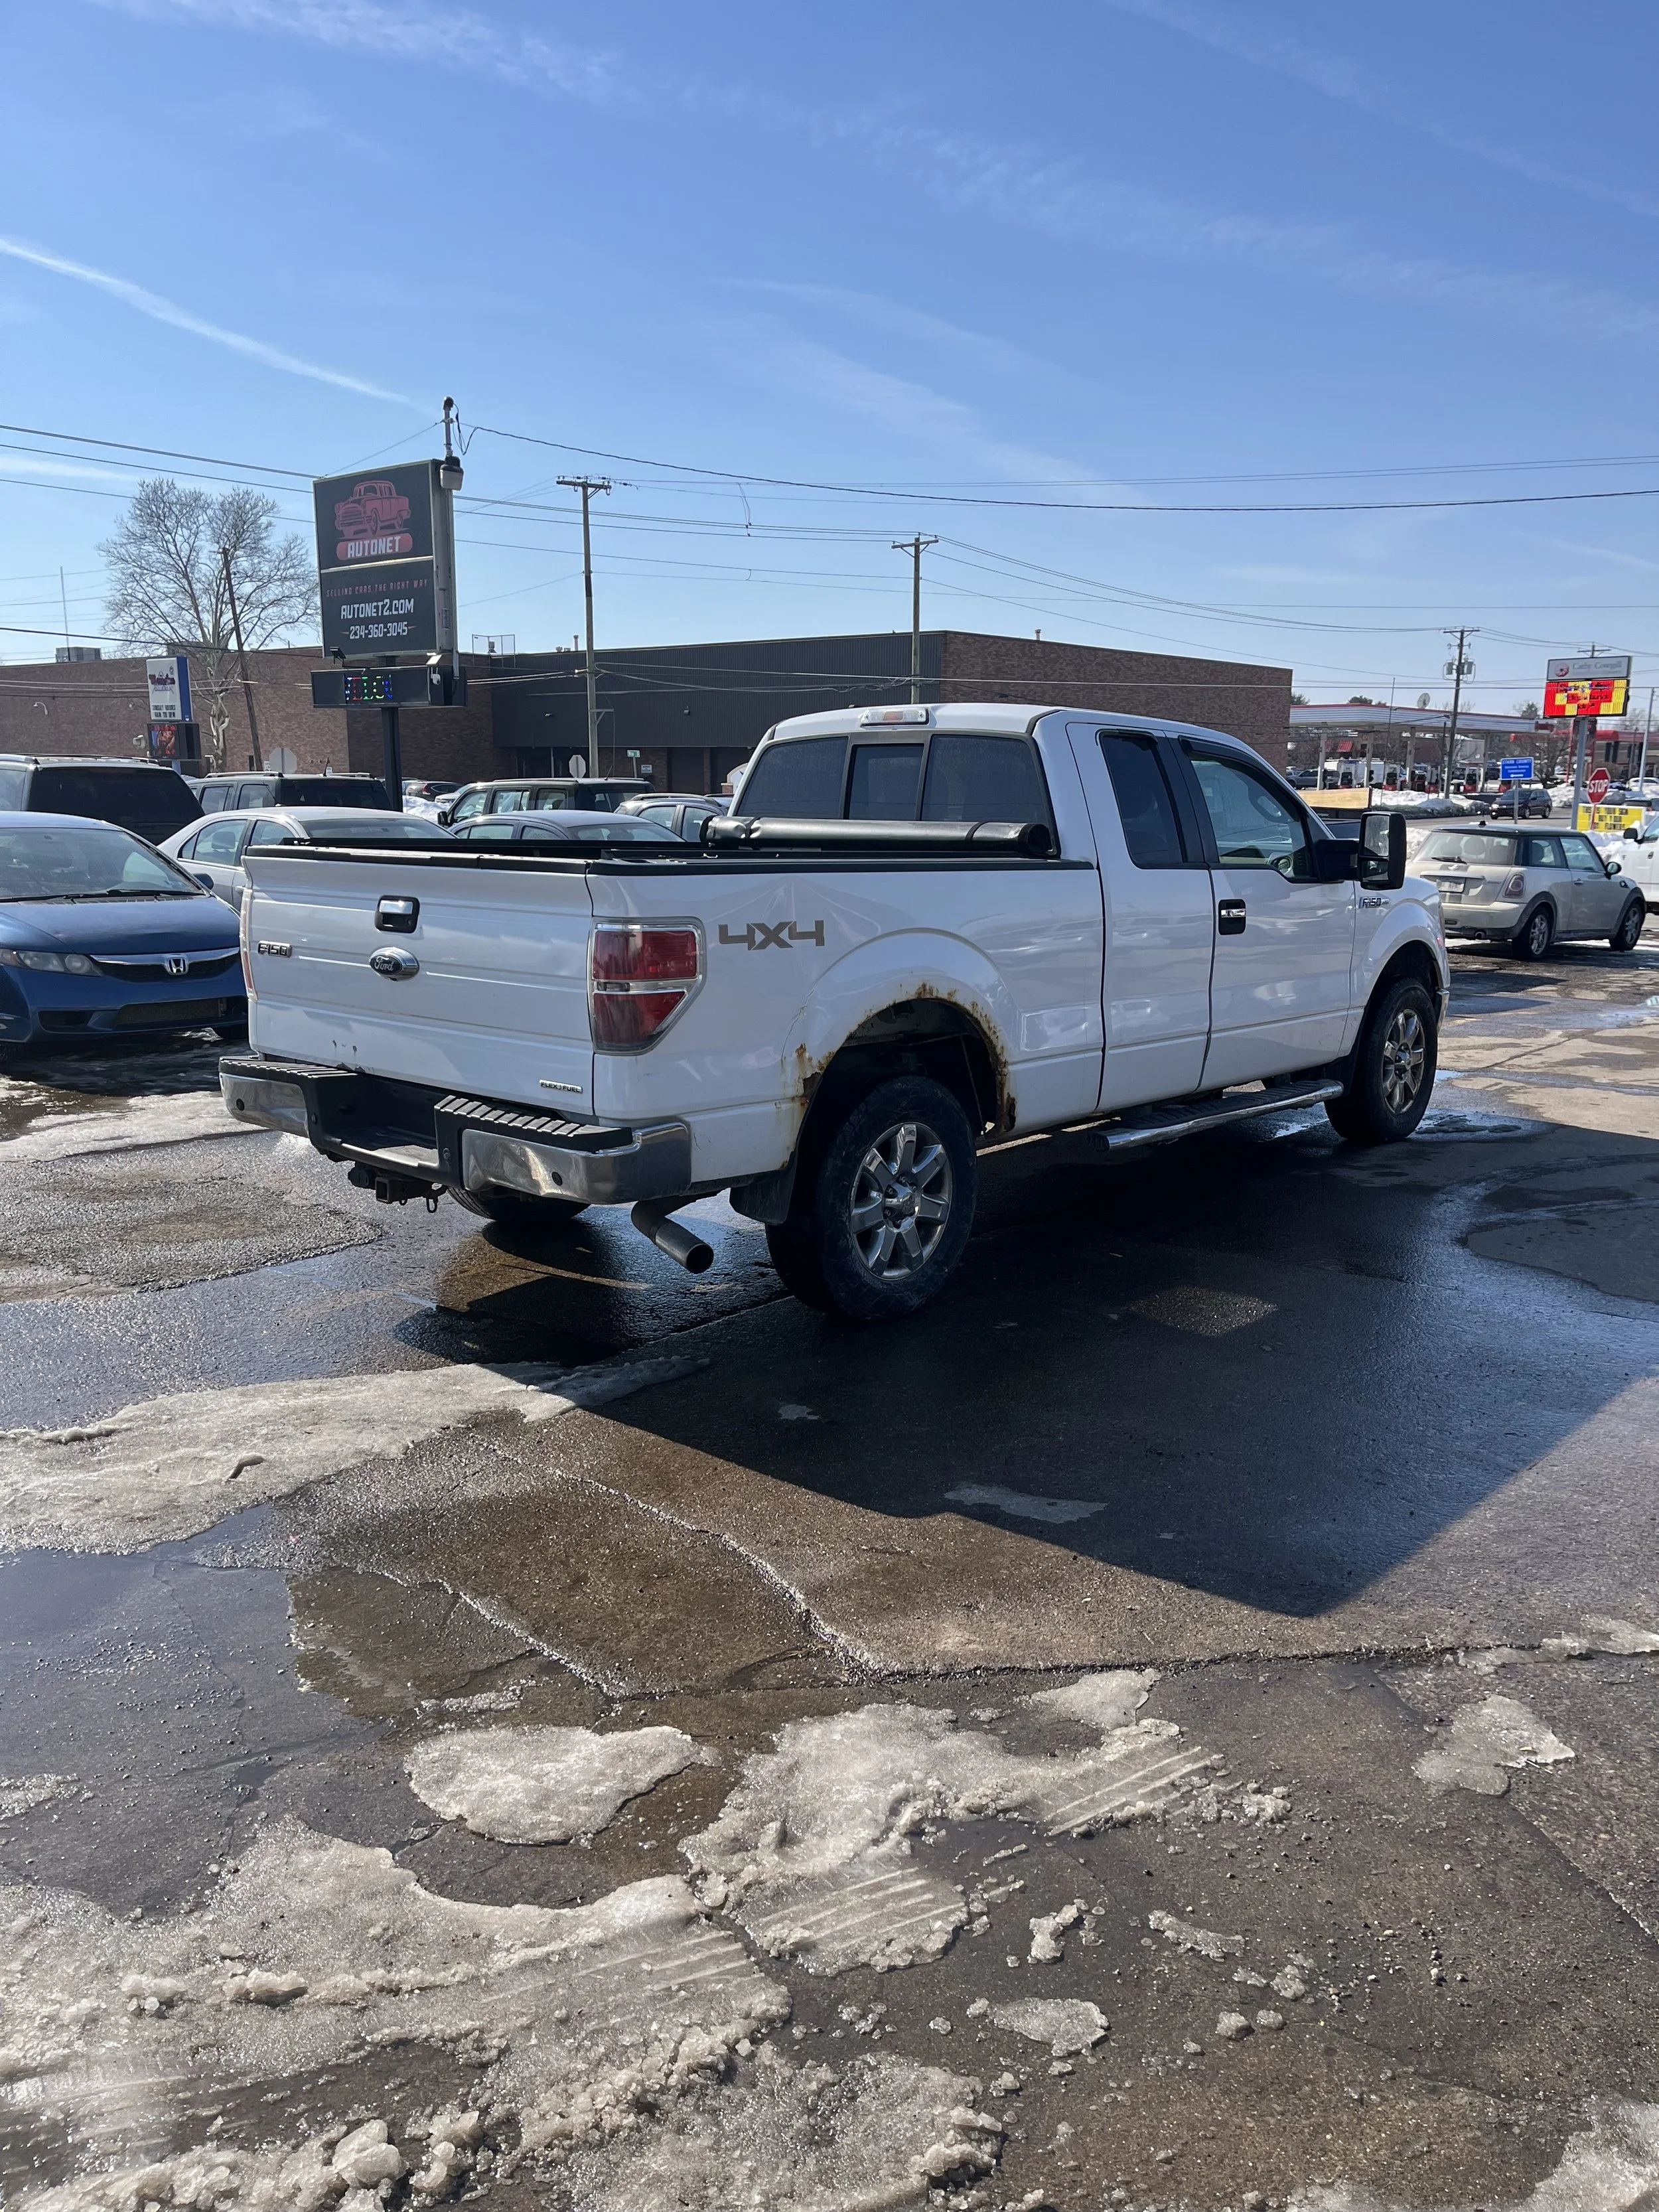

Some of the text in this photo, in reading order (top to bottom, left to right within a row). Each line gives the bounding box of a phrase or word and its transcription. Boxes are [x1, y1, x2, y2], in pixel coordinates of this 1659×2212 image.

[348, 536, 401, 558] AUTONET
[326, 587, 352, 597] SELLING
[355, 585, 371, 594] CARS
[375, 583, 387, 592] THE
[413, 579, 428, 589] WAY
[340, 598, 414, 619] AUTONET2.COM
[349, 622, 408, 640] 234-360-3045
[1589, 779, 1609, 793] STOP
[718, 920, 825, 951] 4X4
[374, 956, 394, 971] Ford
